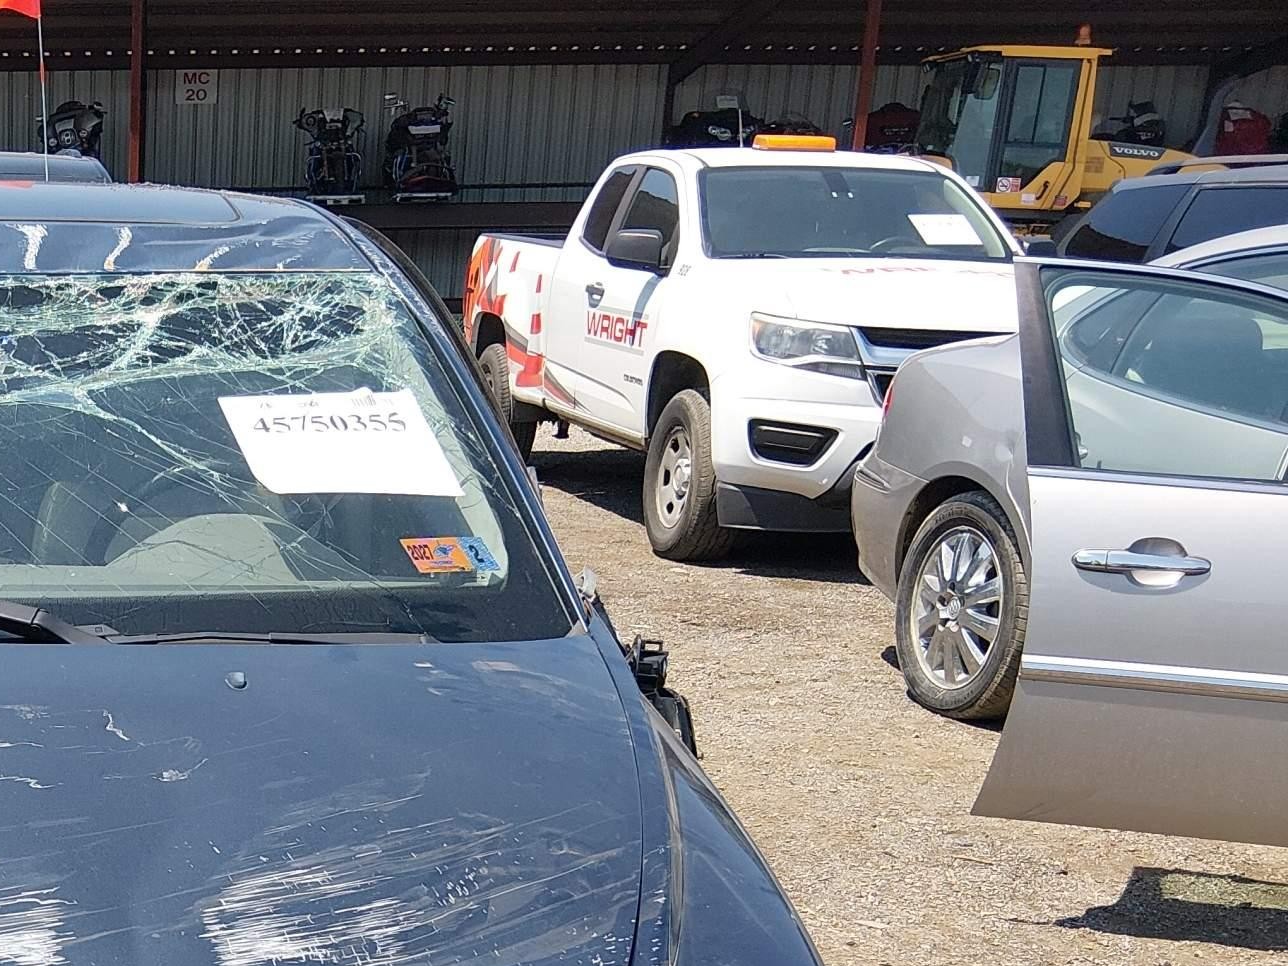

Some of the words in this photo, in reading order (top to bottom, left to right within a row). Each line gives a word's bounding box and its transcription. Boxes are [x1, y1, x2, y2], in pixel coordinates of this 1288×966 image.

[184, 72, 210, 85] MC
[185, 88, 208, 101] 20
[1113, 146, 1160, 157] VOLVO
[587, 310, 648, 347] WRIGHT
[253, 411, 407, 433] 45750355
[406, 544, 434, 560] 2027
[468, 544, 485, 563] 2
